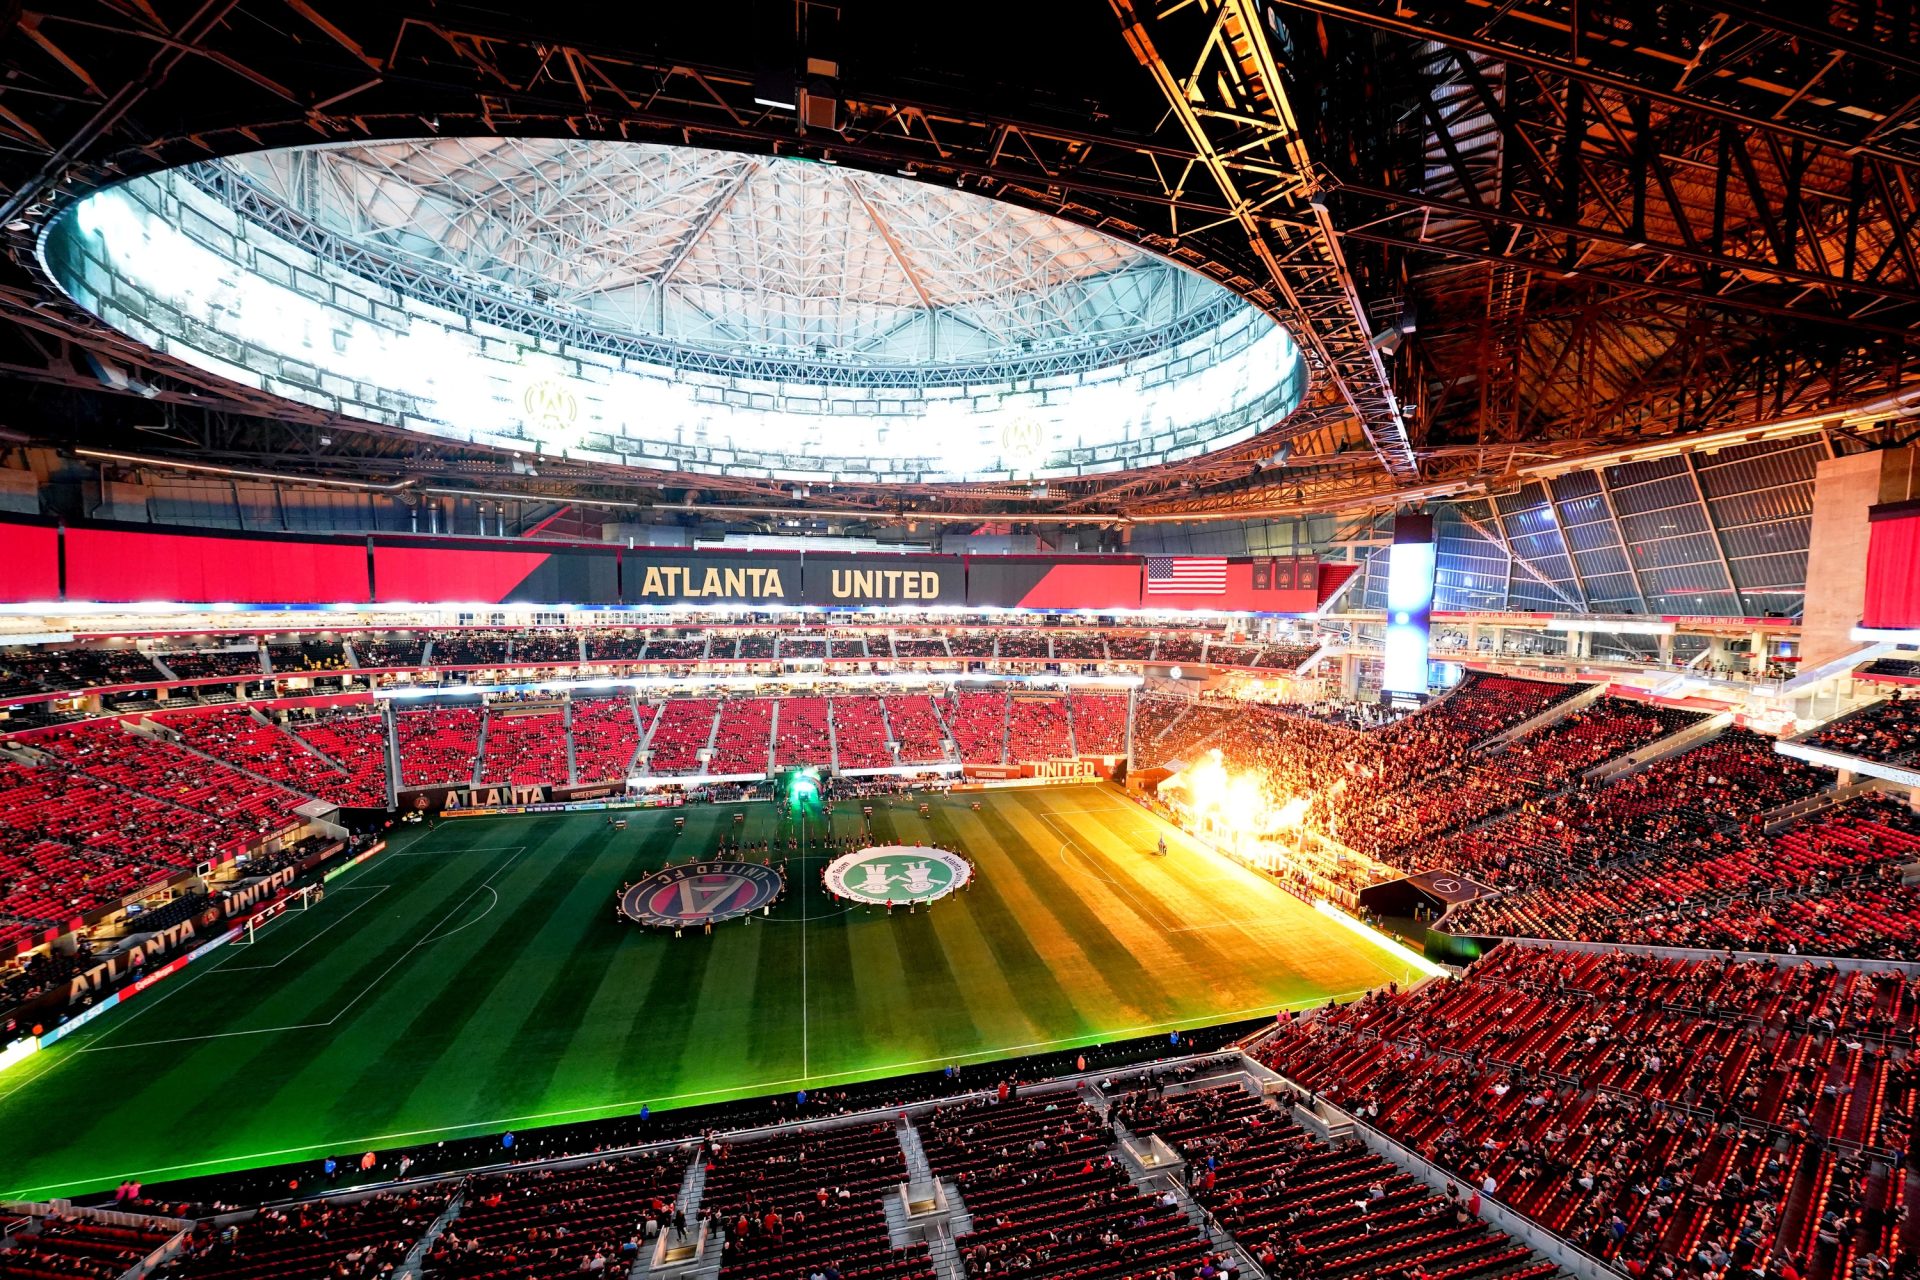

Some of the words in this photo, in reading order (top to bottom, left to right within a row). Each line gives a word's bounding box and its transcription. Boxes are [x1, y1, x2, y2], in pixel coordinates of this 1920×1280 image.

[641, 566, 784, 597] ATLANTA
[832, 569, 940, 599] UNITED
[1679, 616, 1711, 624] ATLANTA
[1034, 761, 1095, 778] UNITED
[444, 786, 546, 809] ATLANTA
[657, 869, 686, 885] FC
[696, 864, 768, 881] UNITED
[224, 866, 295, 918] UNITED
[636, 907, 750, 926] ATANTA
[68, 918, 196, 1006] ATLANTA
